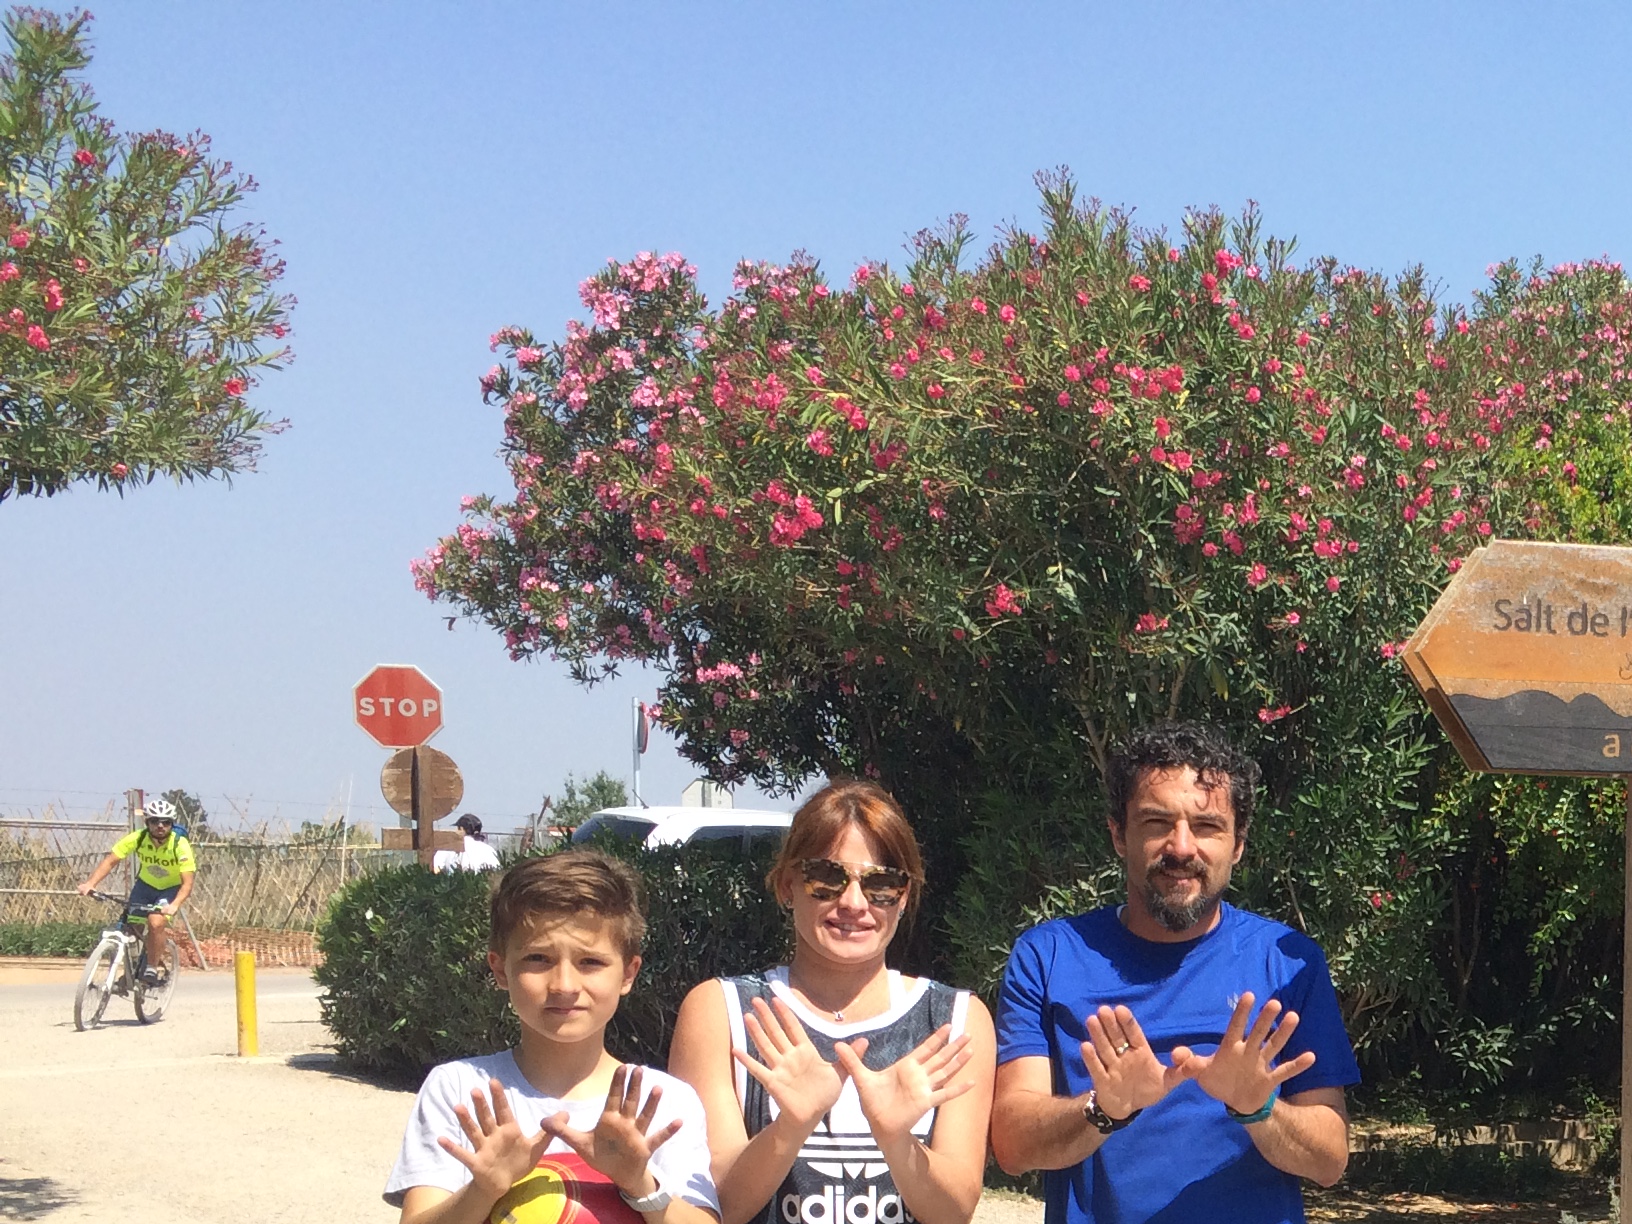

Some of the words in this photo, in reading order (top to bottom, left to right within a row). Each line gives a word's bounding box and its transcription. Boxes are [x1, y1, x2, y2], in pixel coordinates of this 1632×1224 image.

[1493, 597, 1558, 635] Salt
[1567, 601, 1611, 637] de
[359, 697, 438, 718] STOP
[1602, 733, 1620, 758] a
